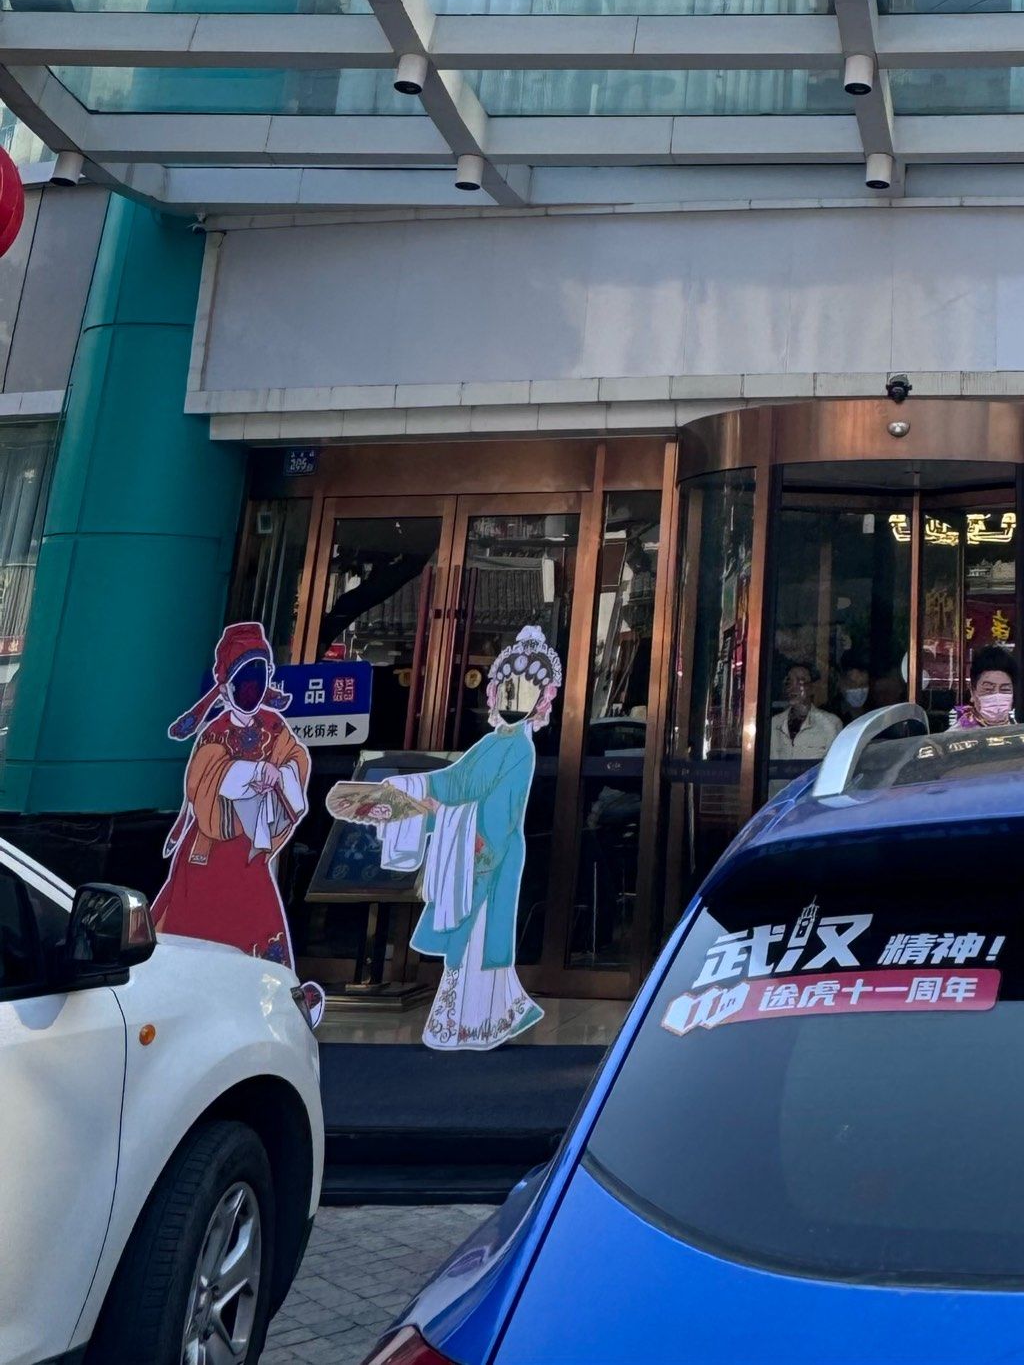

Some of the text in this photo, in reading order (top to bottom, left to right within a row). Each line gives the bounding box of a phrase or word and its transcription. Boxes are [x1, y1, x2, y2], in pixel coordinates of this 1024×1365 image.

[758, 975, 978, 1011] 途虎十一周年
